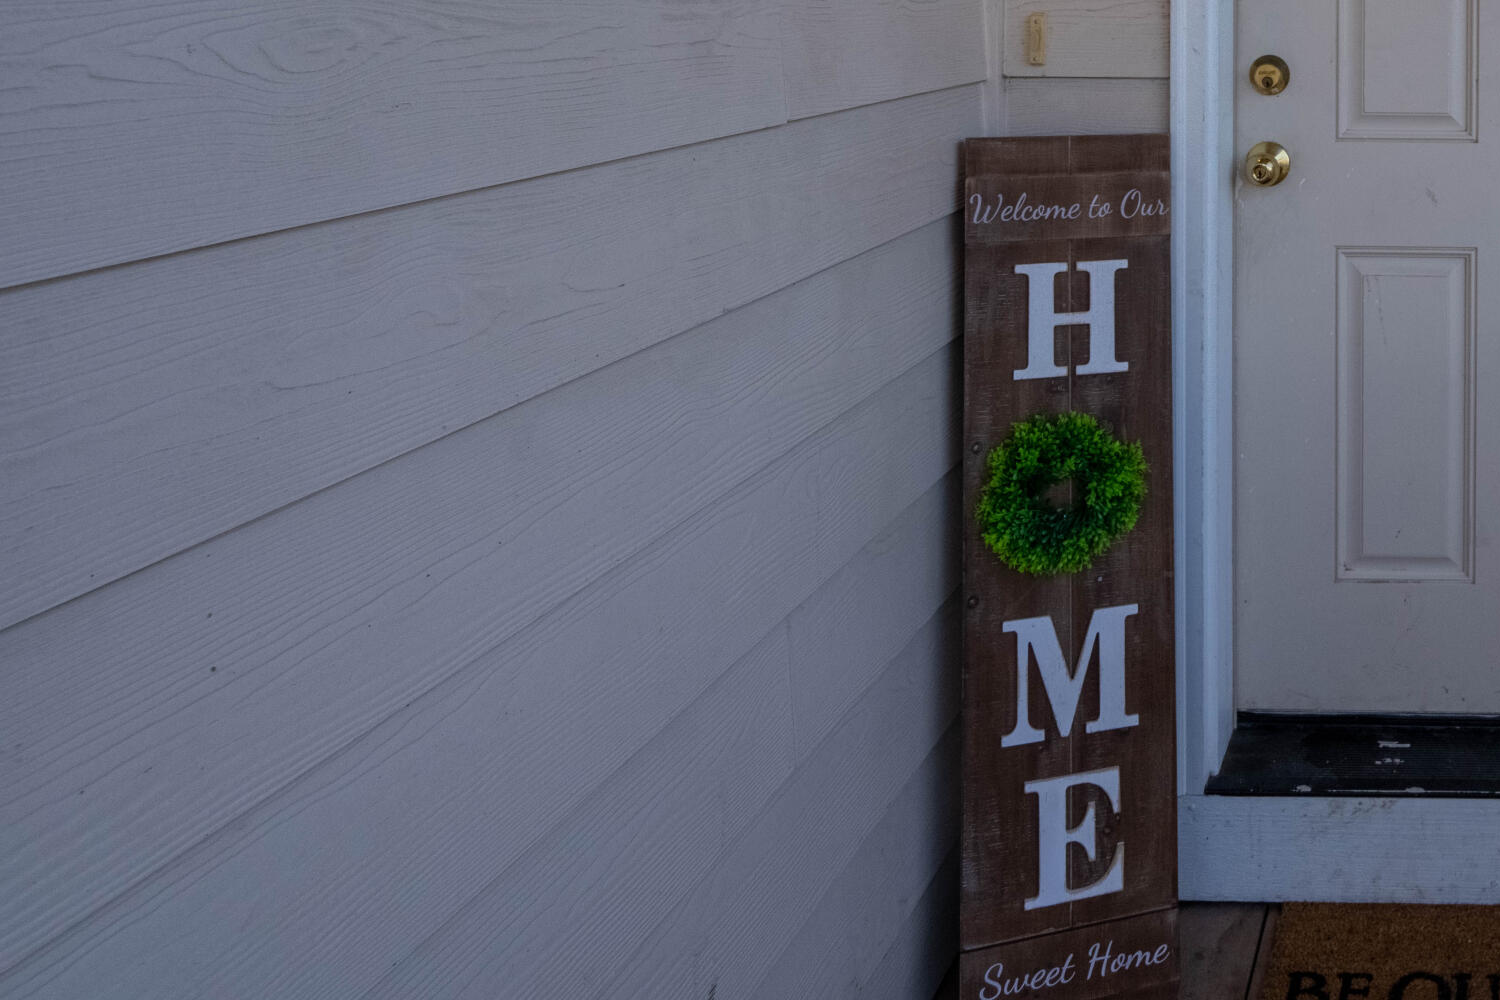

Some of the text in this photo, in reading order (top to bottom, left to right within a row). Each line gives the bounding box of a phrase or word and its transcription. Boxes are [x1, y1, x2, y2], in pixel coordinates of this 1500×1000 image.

[969, 187, 1169, 225] Welcome to Our
[1001, 258, 1140, 912] HME
[979, 939, 1171, 1000] Sweet Home
